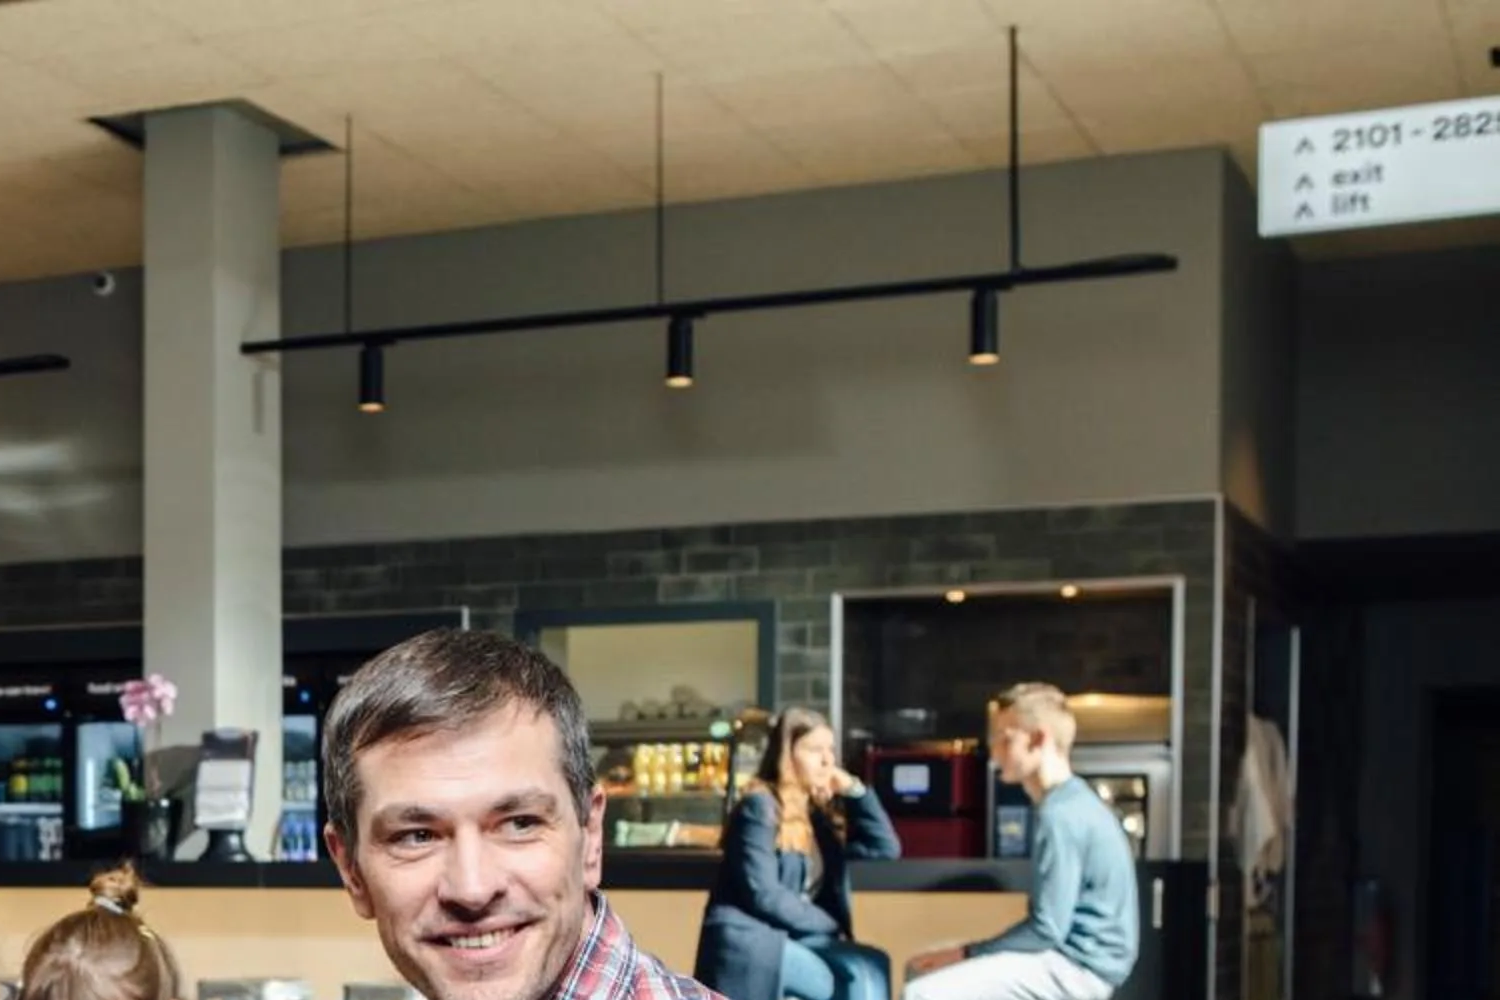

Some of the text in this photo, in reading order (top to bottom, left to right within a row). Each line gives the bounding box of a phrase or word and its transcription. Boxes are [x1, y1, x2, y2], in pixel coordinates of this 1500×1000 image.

[1332, 122, 1402, 152] 2101
[1432, 110, 1500, 141] 282
[1331, 163, 1384, 186] exit
[1332, 192, 1370, 215] lift
